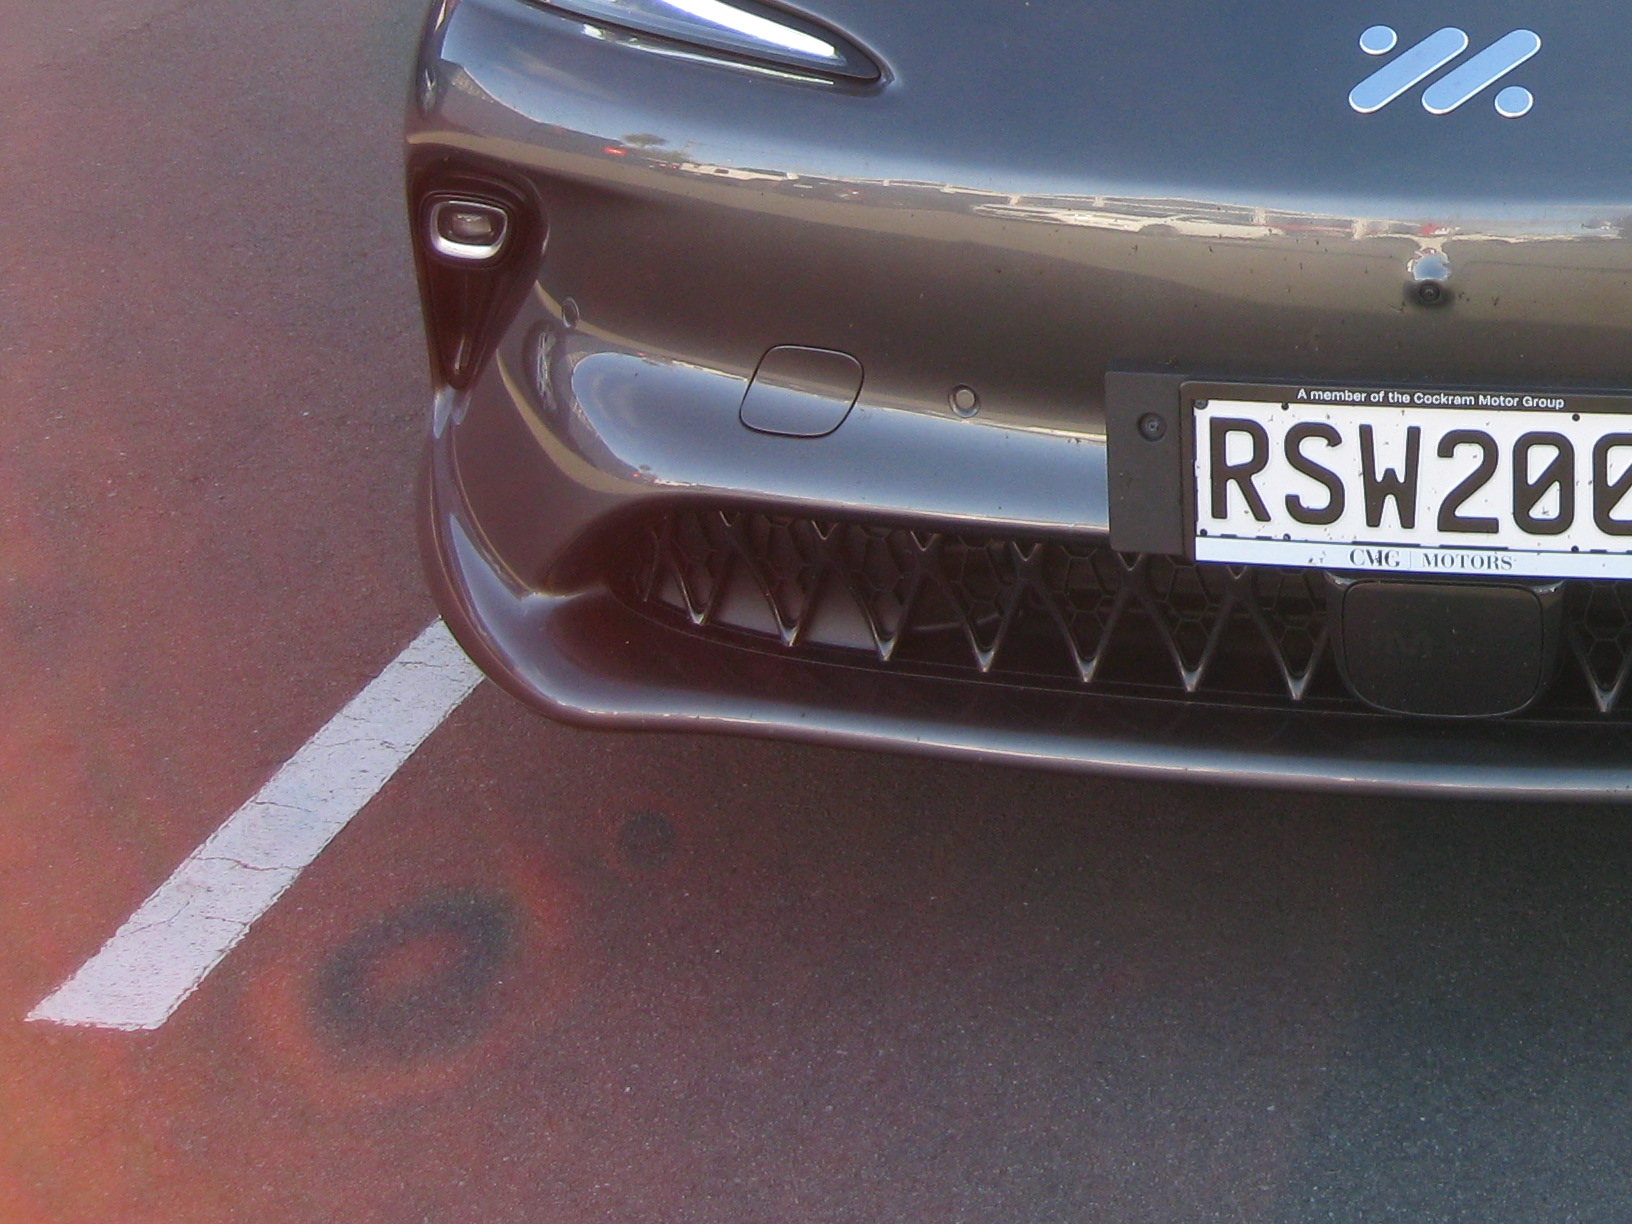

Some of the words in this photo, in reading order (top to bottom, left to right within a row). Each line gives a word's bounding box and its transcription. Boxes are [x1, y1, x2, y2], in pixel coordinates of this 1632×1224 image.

[1297, 388, 1308, 400] A
[1310, 390, 1367, 402] member
[1370, 391, 1385, 403] of
[1388, 392, 1411, 404] the
[1414, 392, 1475, 406] Cockram
[1478, 394, 1520, 407] Motor
[1522, 396, 1566, 410] Group
[1349, 548, 1401, 568] CMG
[1422, 552, 1514, 571] MOTORS
